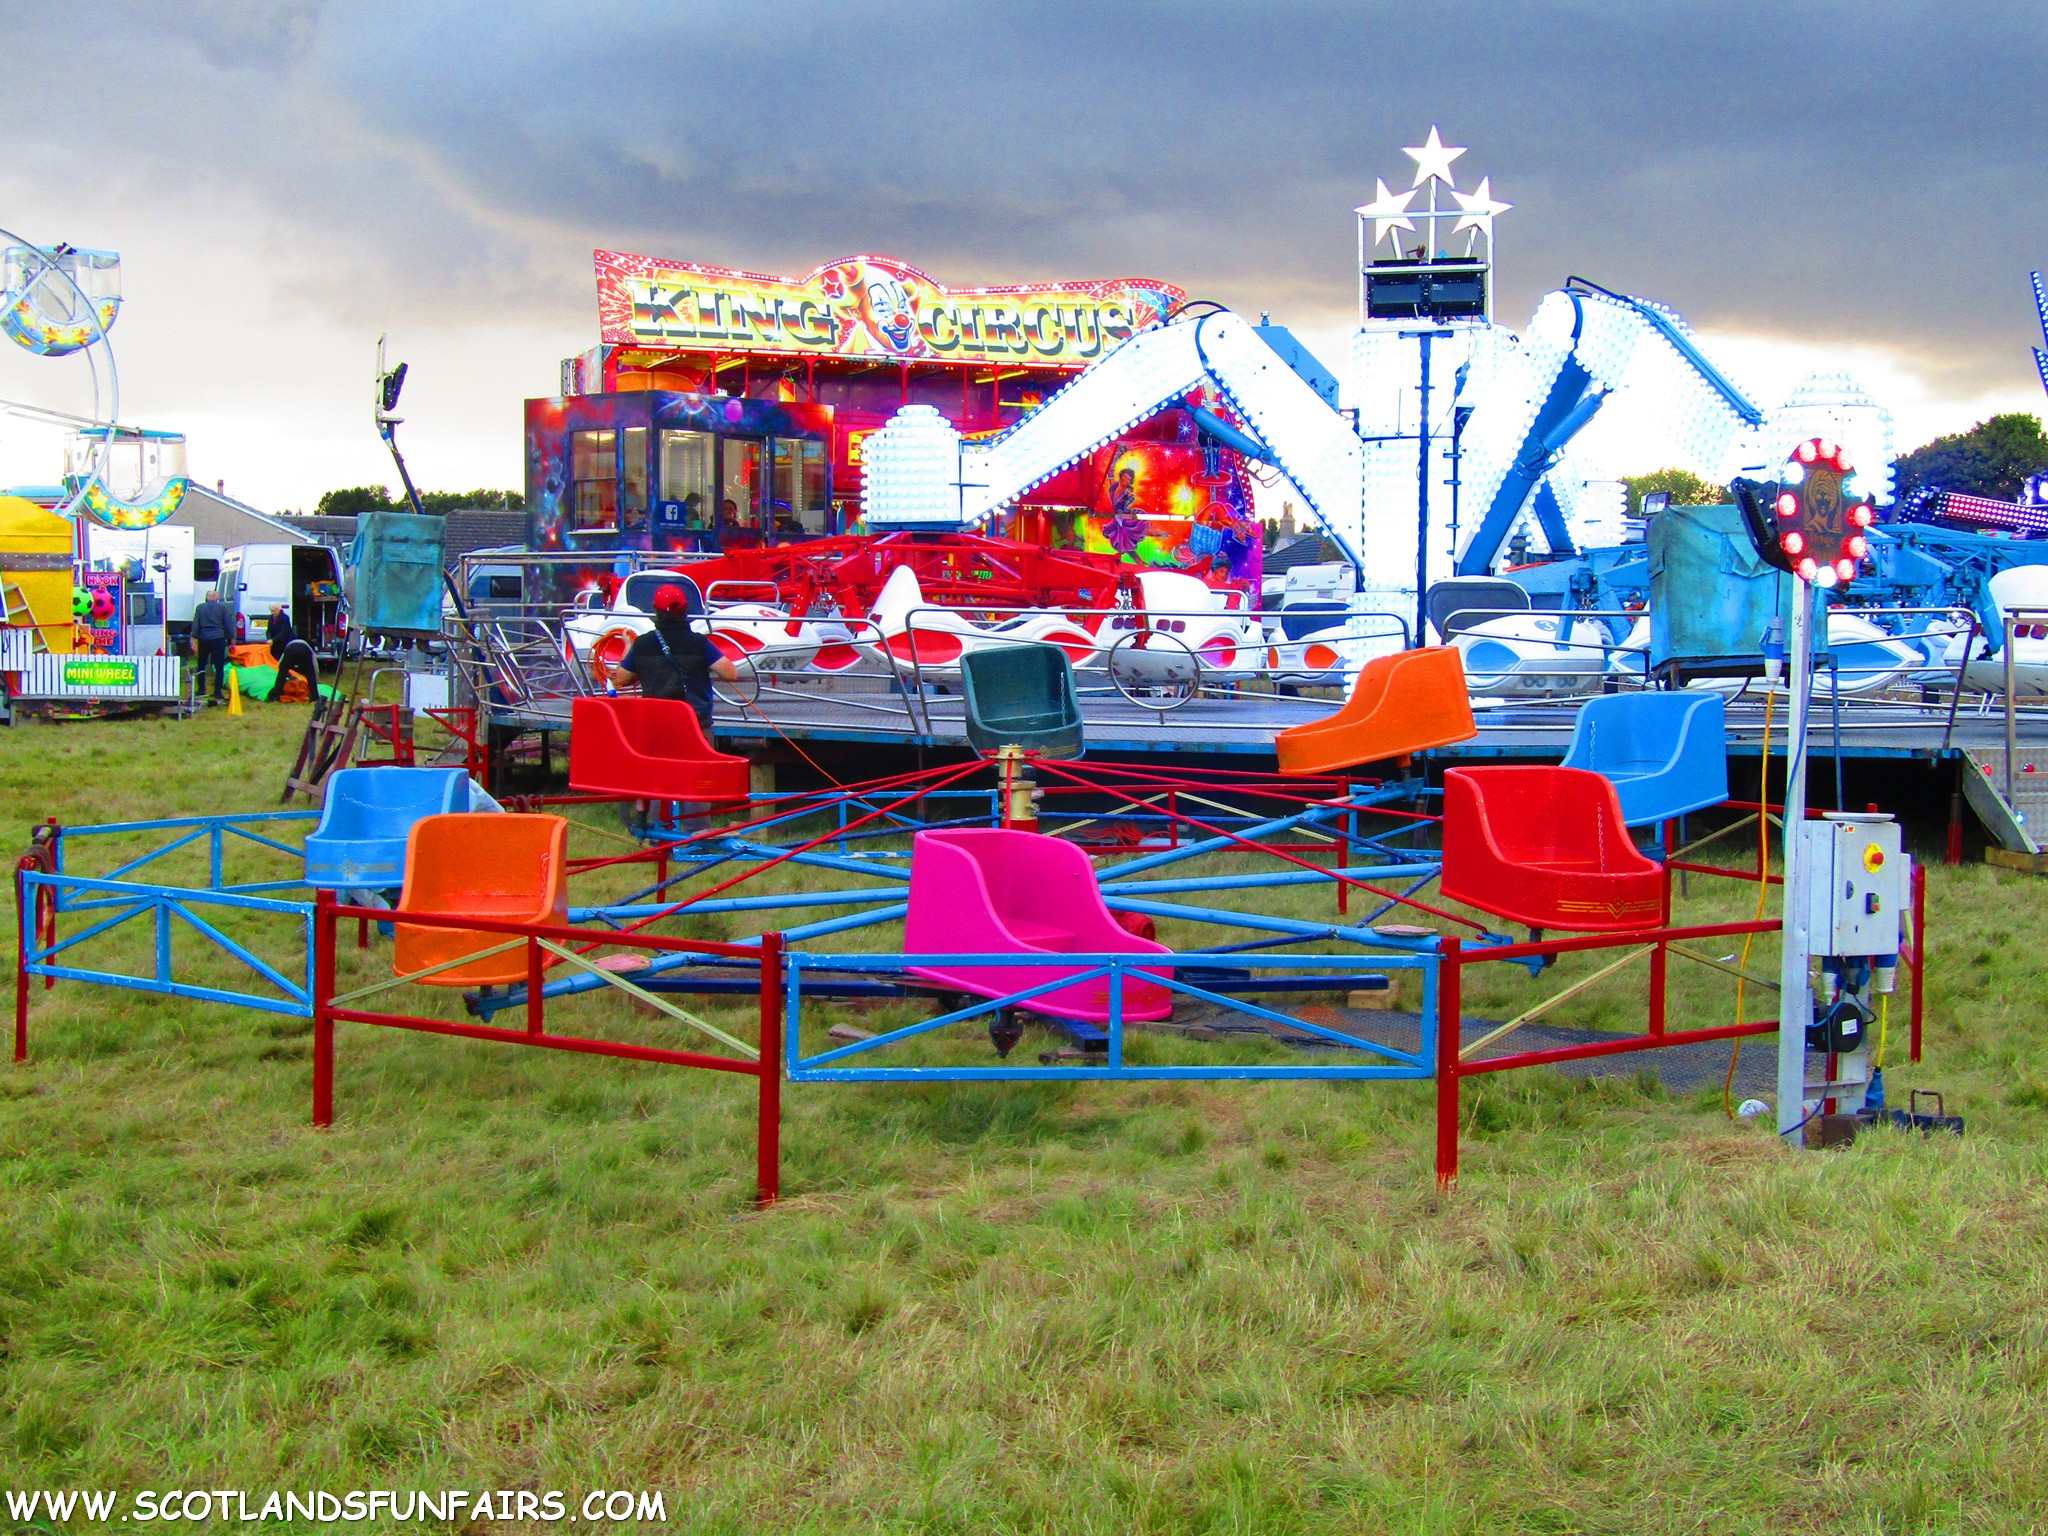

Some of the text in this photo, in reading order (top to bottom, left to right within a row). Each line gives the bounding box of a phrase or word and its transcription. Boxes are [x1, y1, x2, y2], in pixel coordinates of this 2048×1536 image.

[627, 279, 1136, 358] KING CIRCUS
[87, 575, 118, 586] HOOK
[67, 668, 135, 679] MINI WHEEL
